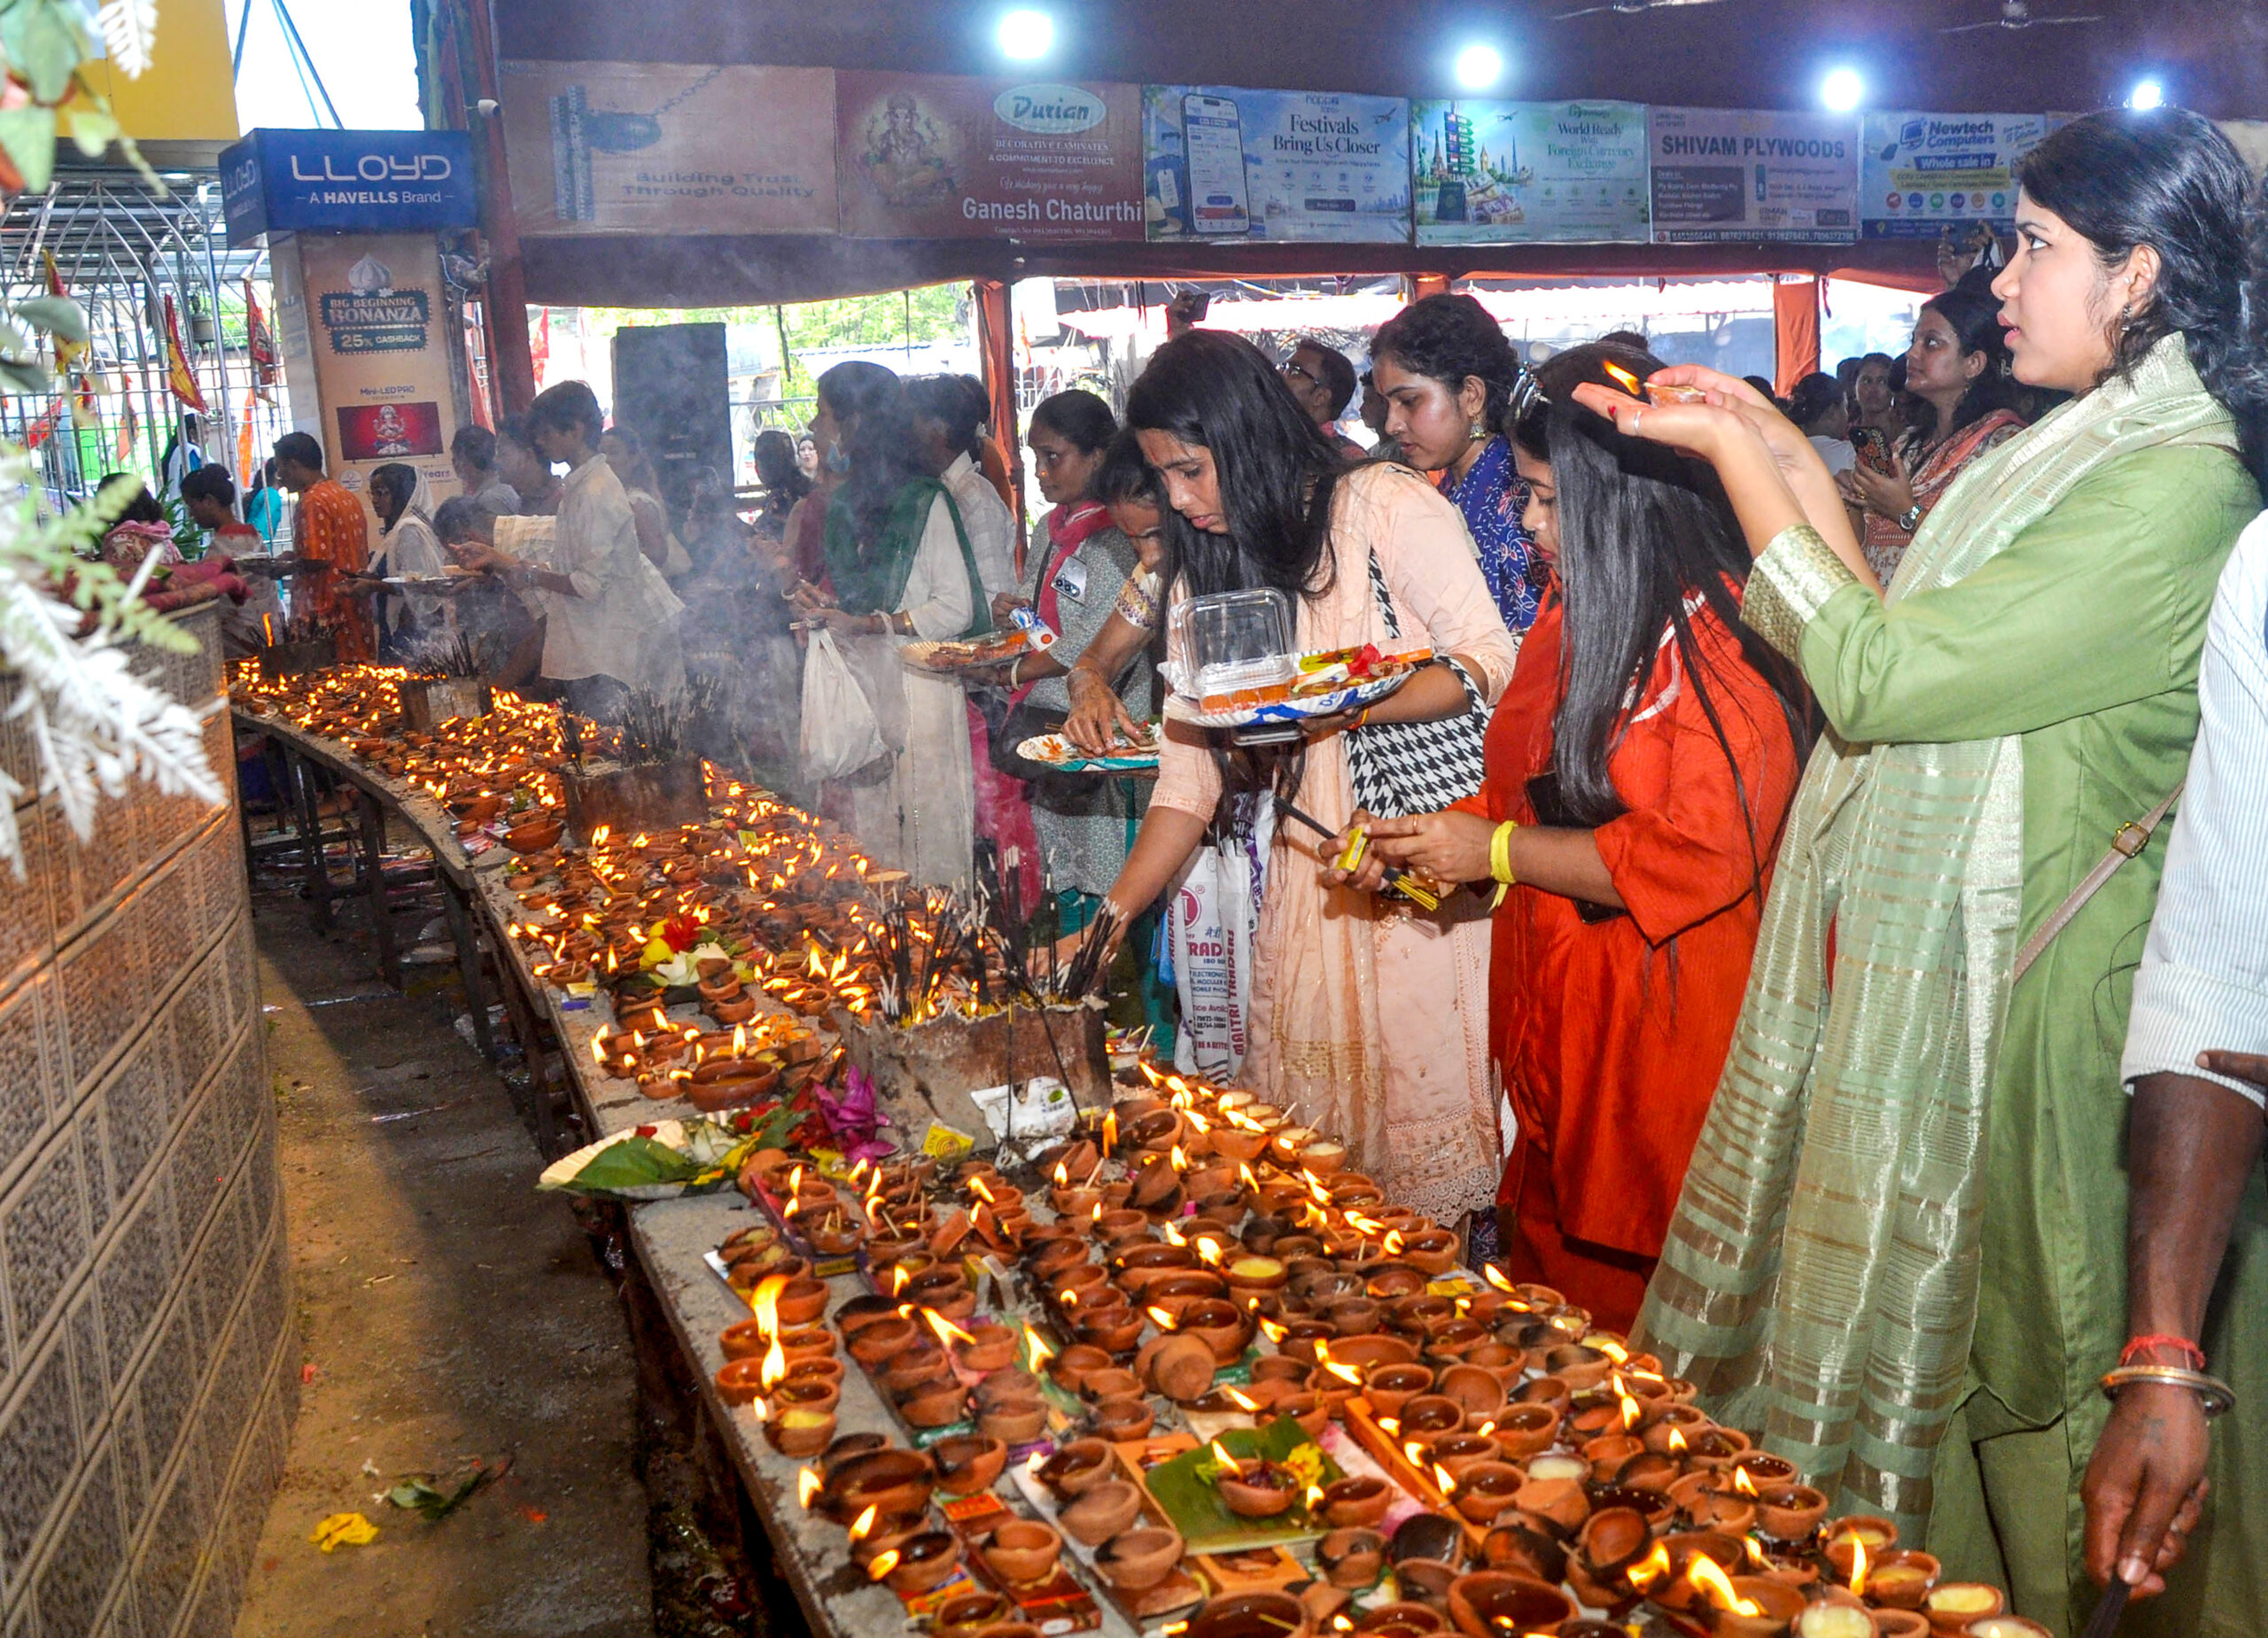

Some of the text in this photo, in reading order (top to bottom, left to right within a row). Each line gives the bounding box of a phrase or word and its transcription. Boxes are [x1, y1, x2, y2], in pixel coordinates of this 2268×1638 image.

[1013, 96, 1090, 120] Durian
[1290, 113, 1360, 135] Festivals
[1557, 122, 1590, 136] World
[1930, 120, 1993, 135] Newtech
[1273, 135, 1381, 155] Bring Us Closer
[1661, 135, 1845, 159] SHIVAM PLYWOODS
[1927, 135, 1995, 149] Computers
[291, 155, 452, 182] LLOYD
[636, 173, 734, 185] Building
[310, 191, 441, 204] A HAVELLS Brand
[622, 185, 816, 198] Through Quality
[962, 198, 1142, 222] Ganesh Chaturthi
[330, 296, 416, 307] BIG BEGINNING
[329, 307, 423, 323] BONANZA
[1188, 942, 1223, 957] RAD
[1226, 928, 1238, 999] TRADERS
